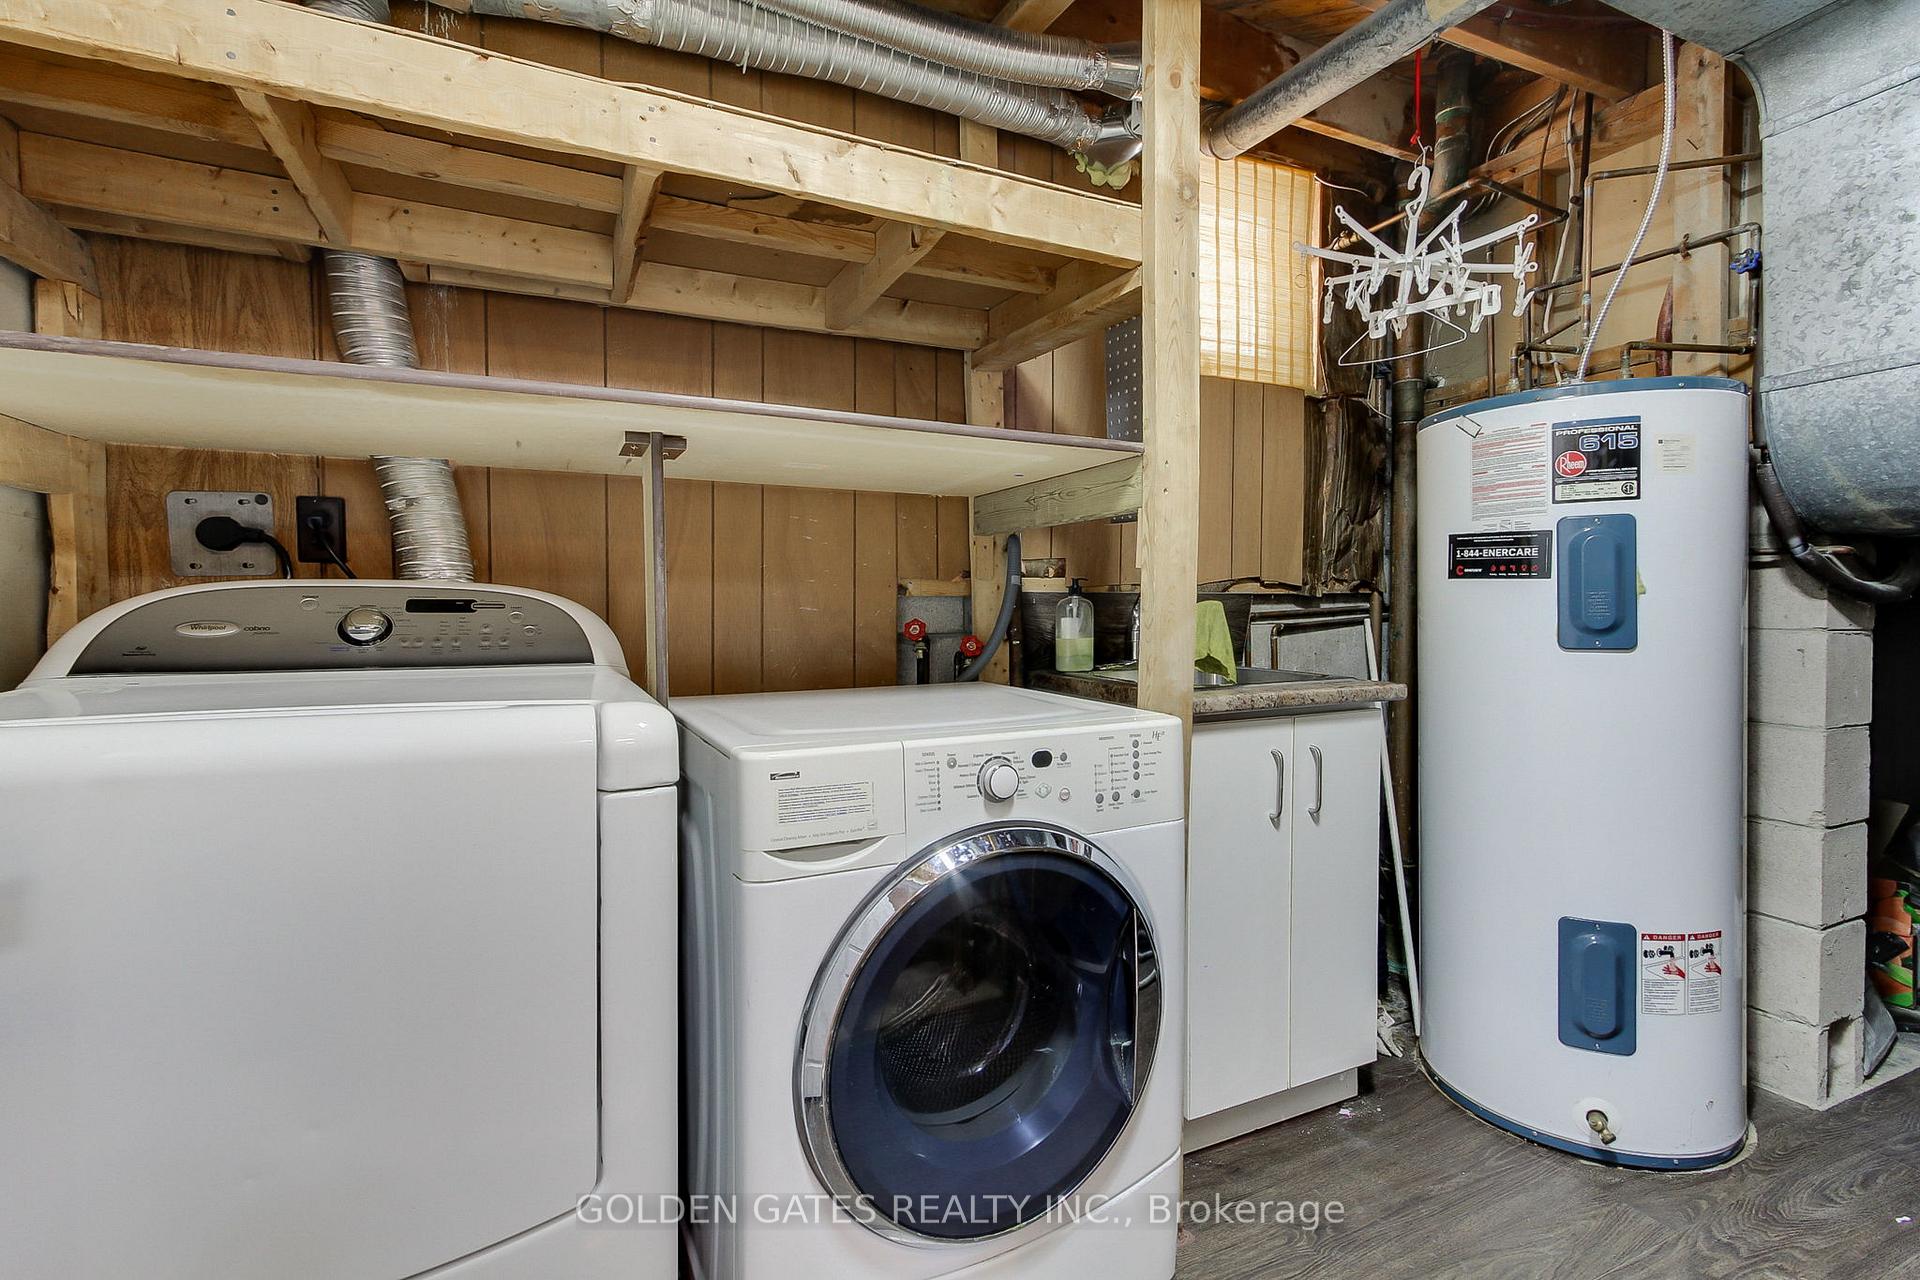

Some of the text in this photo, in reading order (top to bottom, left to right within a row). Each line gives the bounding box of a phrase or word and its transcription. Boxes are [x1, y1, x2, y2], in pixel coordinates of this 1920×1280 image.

[1555, 425, 1638, 436] PROFESSIONAL
[1579, 432, 1639, 452] 615
[1560, 453, 1585, 473] Rheem
[1456, 547, 1539, 558] 1-844-ENERCARE
[190, 623, 227, 631] Whirlpool
